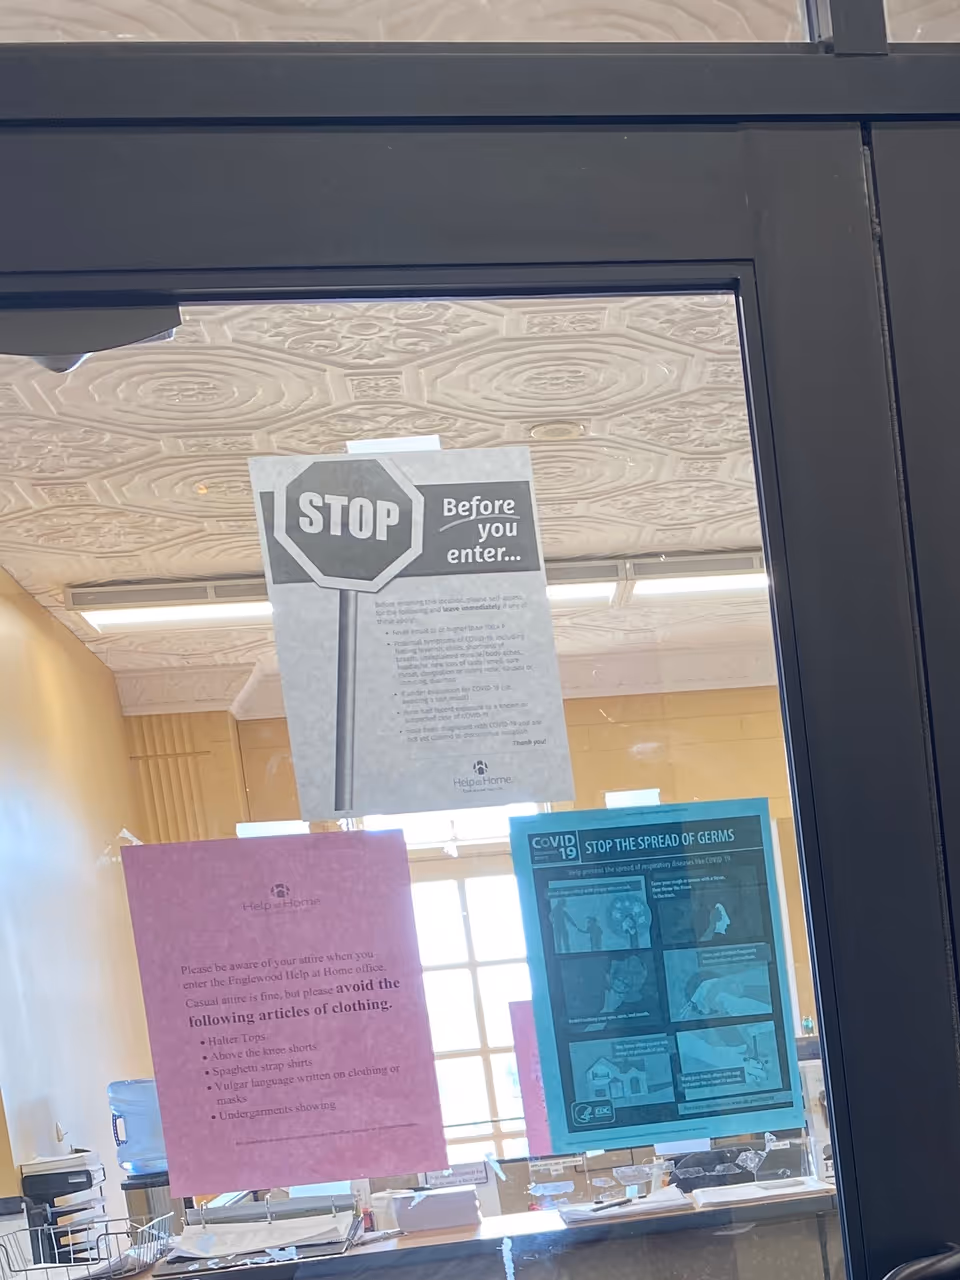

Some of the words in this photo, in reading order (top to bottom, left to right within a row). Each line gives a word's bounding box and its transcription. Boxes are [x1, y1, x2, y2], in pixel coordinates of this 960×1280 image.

[298, 491, 400, 541] STOP
[443, 496, 516, 519] Before
[478, 521, 517, 542] you
[447, 547, 521, 564] enter...
[586, 840, 613, 854] STOP
[614, 838, 637, 852] THE
[638, 834, 679, 850] SPREAD
[681, 832, 694, 846] OF
[697, 828, 735, 844] GERMS
[558, 847, 577, 860] 19
[181, 963, 214, 975] Please
[215, 961, 227, 973] be
[229, 961, 259, 972] aware
[261, 958, 273, 968] of
[274, 957, 296, 969] your
[326, 952, 353, 963] when
[354, 951, 374, 963] you
[183, 979, 208, 990] enter
[210, 976, 225, 987] the
[323, 966, 354, 977] Home
[185, 997, 219, 1009] Casual
[336, 979, 374, 994] avoid
[378, 977, 401, 989] the
[188, 1012, 256, 1029] following
[258, 1007, 311, 1022] articles
[314, 1003, 328, 1016] of
[331, 999, 393, 1015] clothing.
[207, 1035, 239, 1047] Halter
[241, 1033, 266, 1045] Tops
[210, 1050, 243, 1062] Above
[245, 1048, 260, 1059] the
[288, 1042, 317, 1053] shorts
[260, 1061, 284, 1073] strap
[215, 1079, 249, 1092] Vulgar
[251, 1075, 294, 1088] language
[297, 1072, 331, 1084] written
[333, 1071, 346, 1080] on
[347, 1065, 387, 1079] clothing
[216, 1094, 247, 1105] masks
[219, 1106, 293, 1121] Undergarments
[295, 1100, 337, 1113] showing
